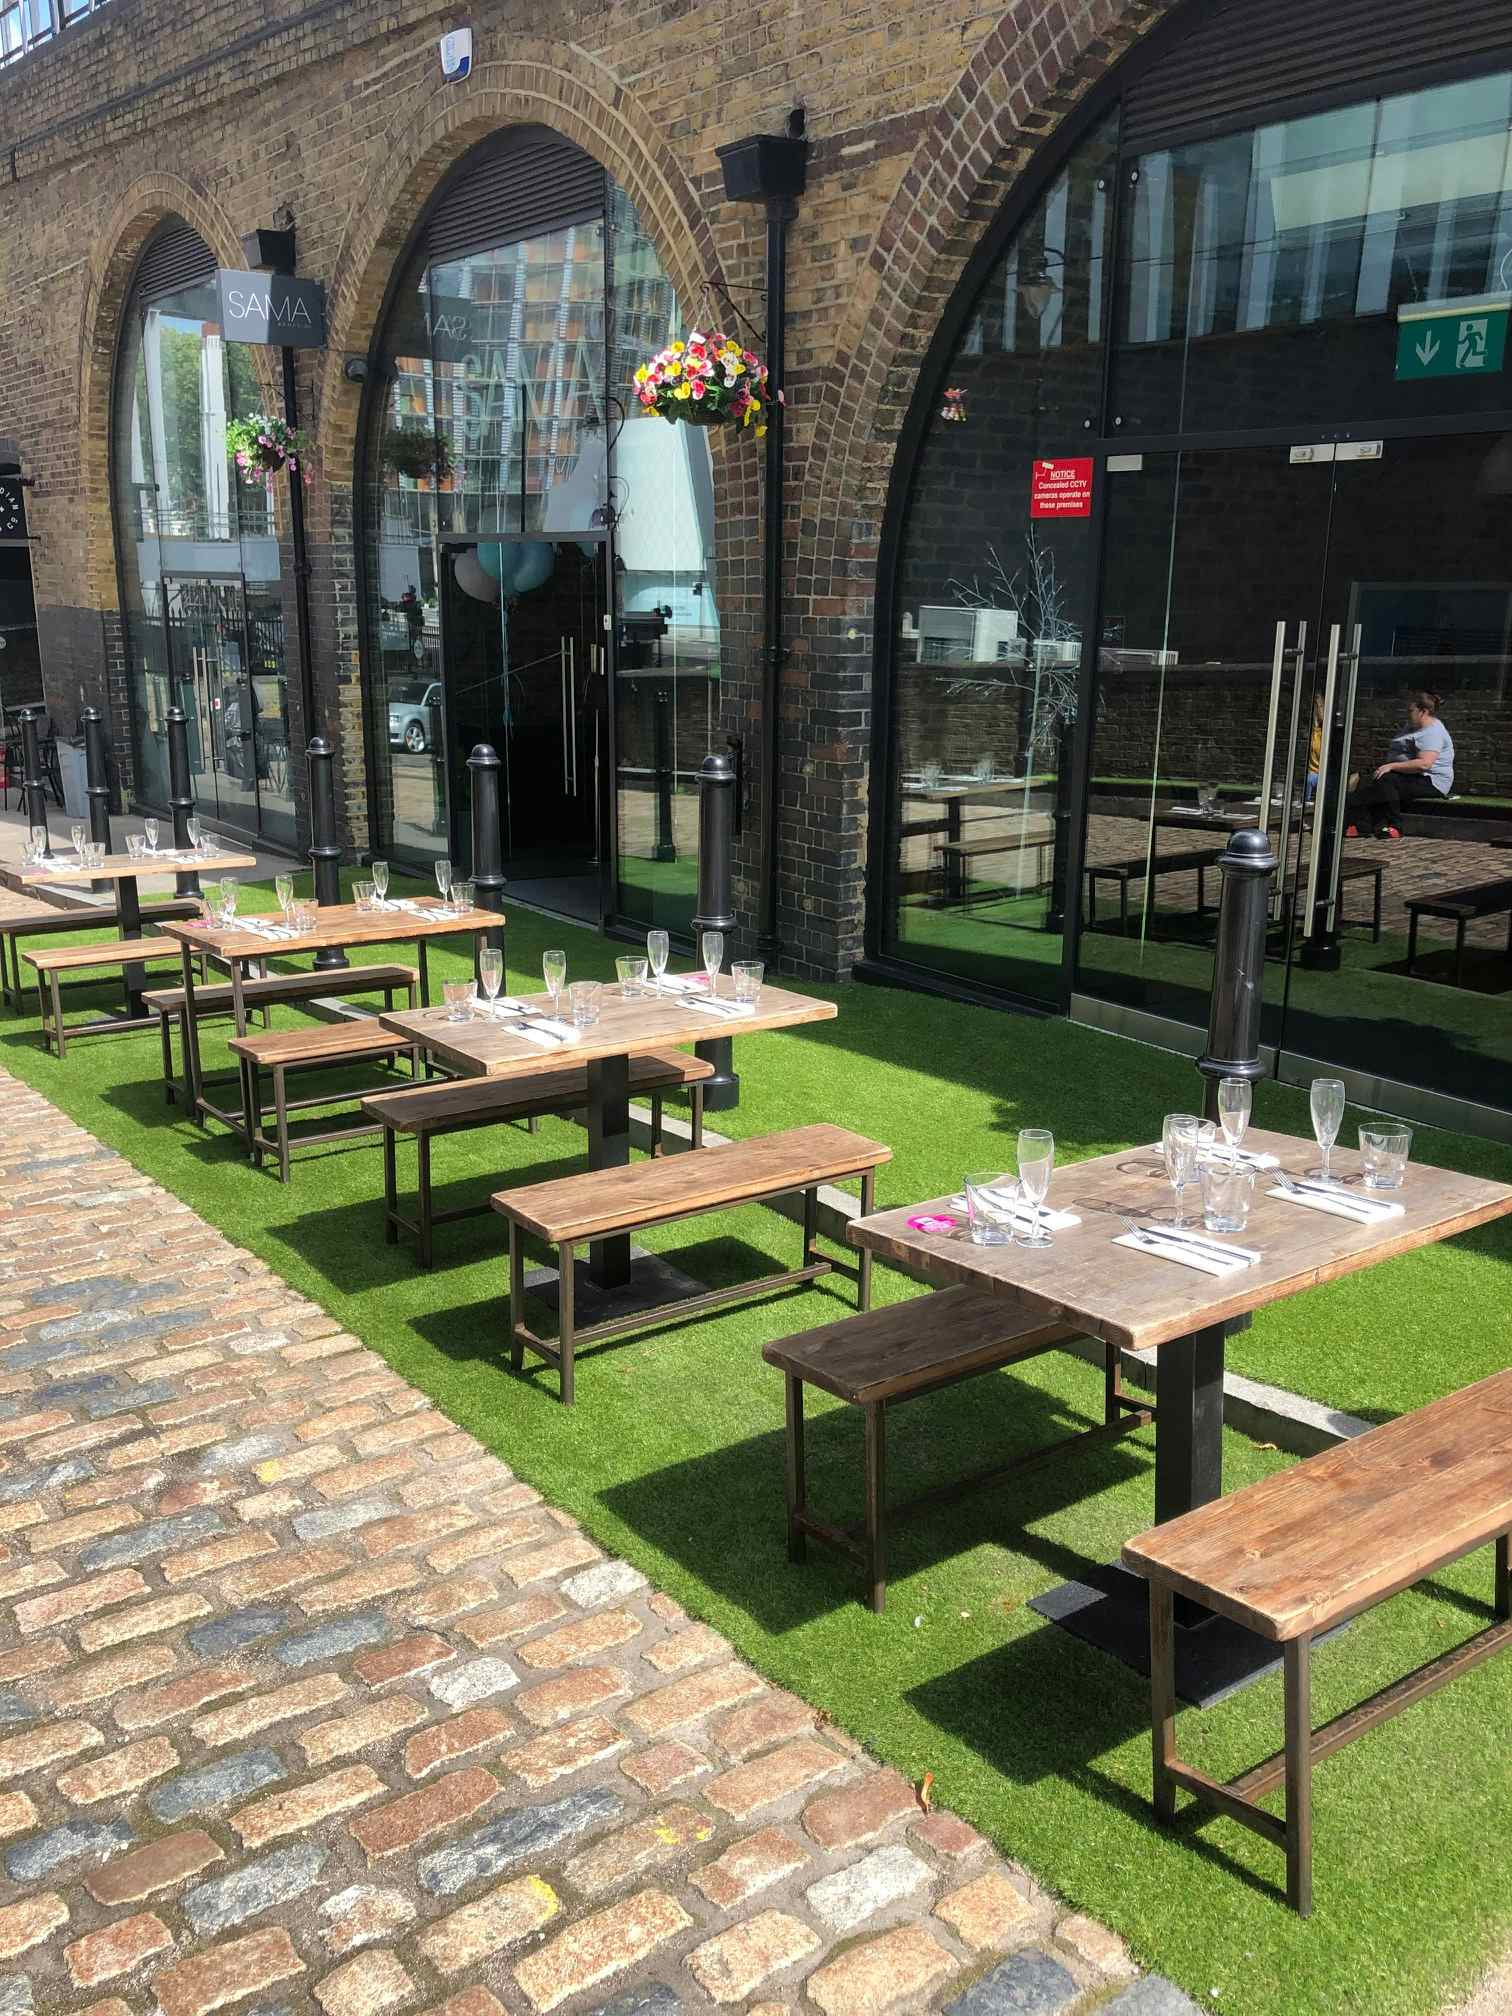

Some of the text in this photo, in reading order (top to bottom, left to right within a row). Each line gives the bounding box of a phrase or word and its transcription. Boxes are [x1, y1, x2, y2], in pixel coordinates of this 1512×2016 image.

[228, 290, 312, 324] SAMA
[1050, 469, 1076, 480] NOTICE
[1039, 480, 1087, 489] Concealed CCTV
[1059, 491, 1081, 500] operate
[1056, 501, 1083, 510] premises
